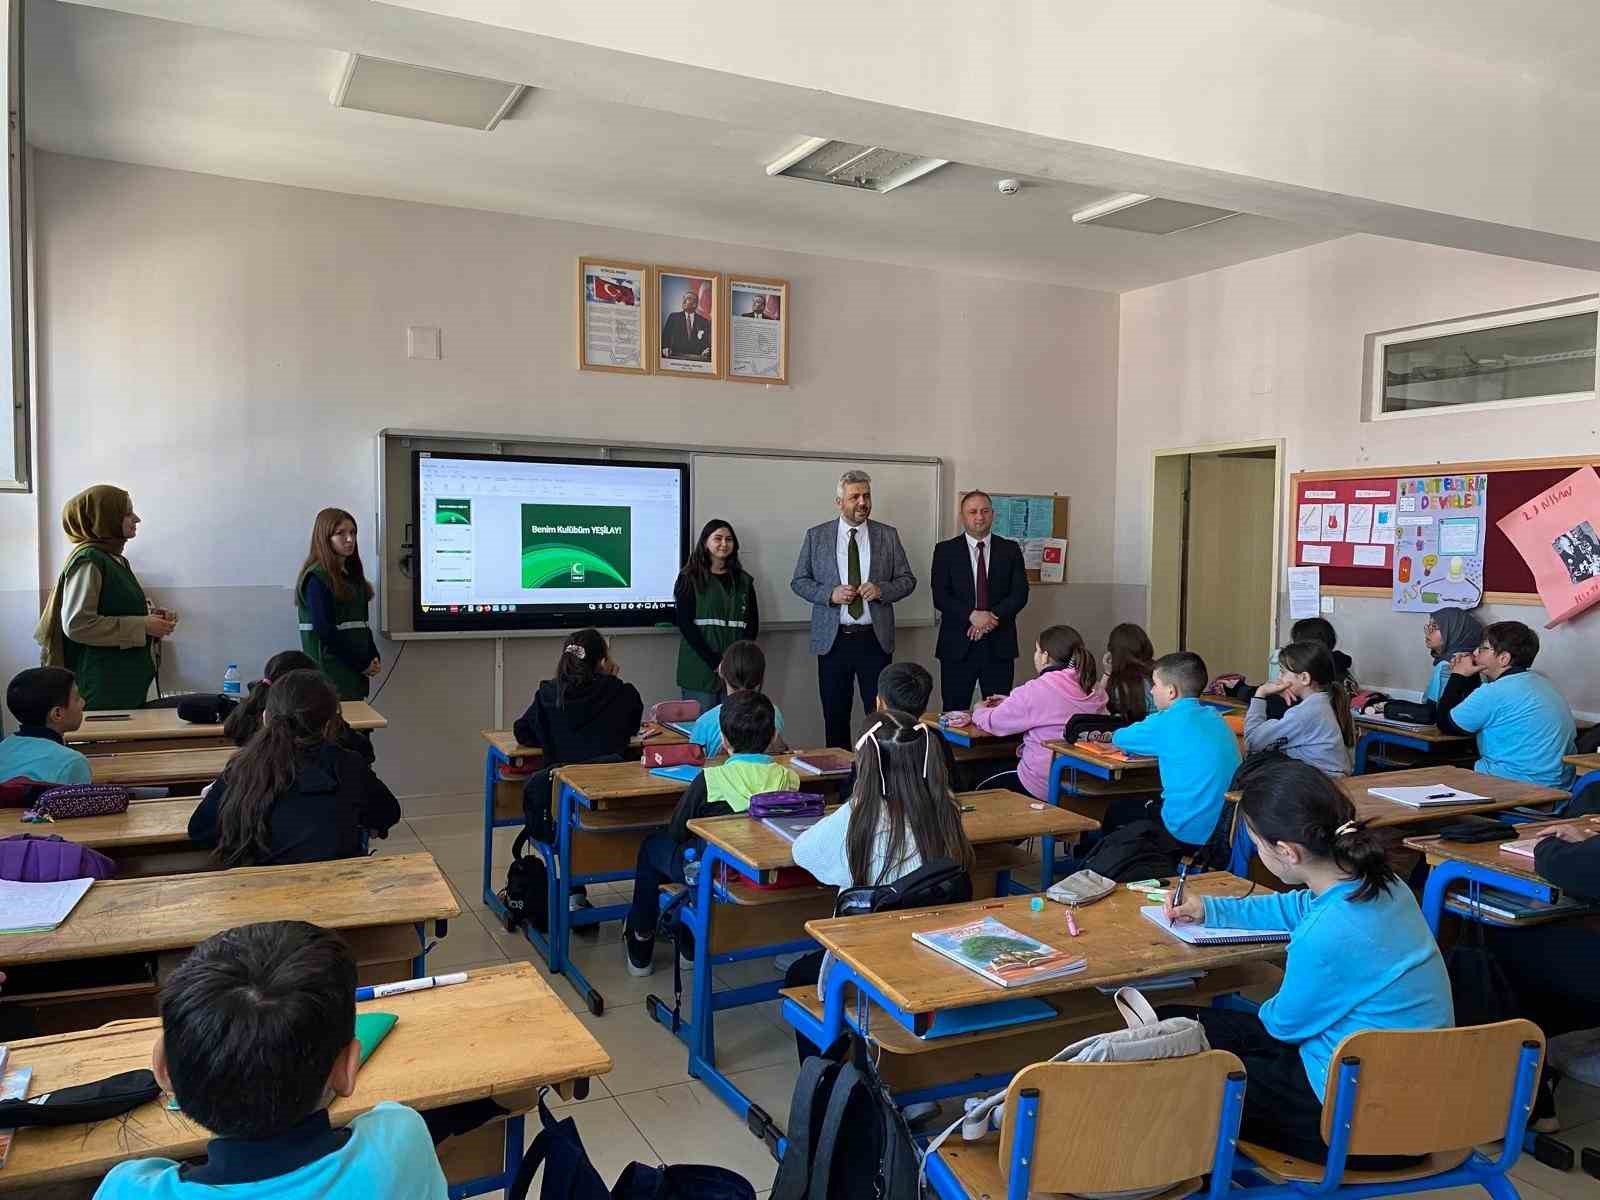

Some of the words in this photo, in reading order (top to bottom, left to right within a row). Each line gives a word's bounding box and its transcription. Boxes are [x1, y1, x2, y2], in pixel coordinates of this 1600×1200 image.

[531, 525, 557, 534] Benim
[557, 526, 590, 535] Kulübüm
[591, 525, 622, 536] YEŞİLAY!
